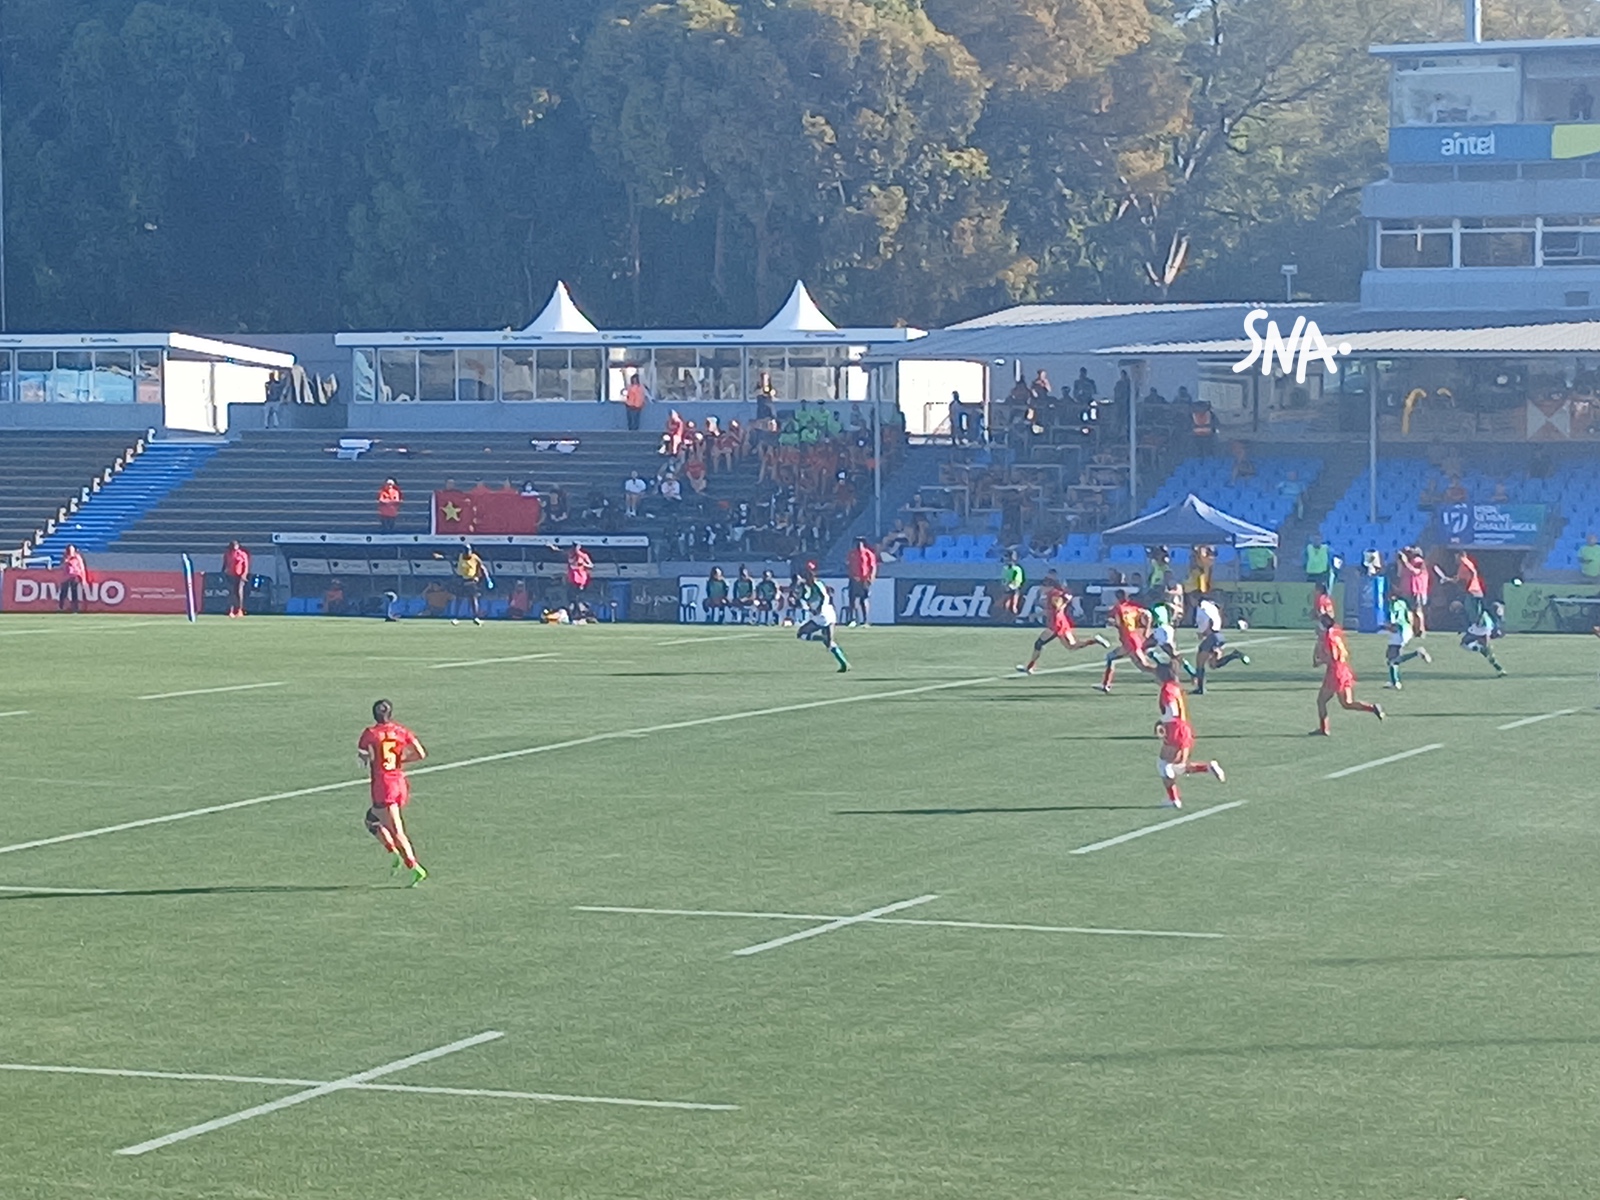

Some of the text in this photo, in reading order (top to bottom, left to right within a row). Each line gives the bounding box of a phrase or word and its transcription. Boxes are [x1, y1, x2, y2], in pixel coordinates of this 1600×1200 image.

[1441, 130, 1495, 156] antel
[900, 584, 991, 617] flash
[382, 741, 397, 771] 5
